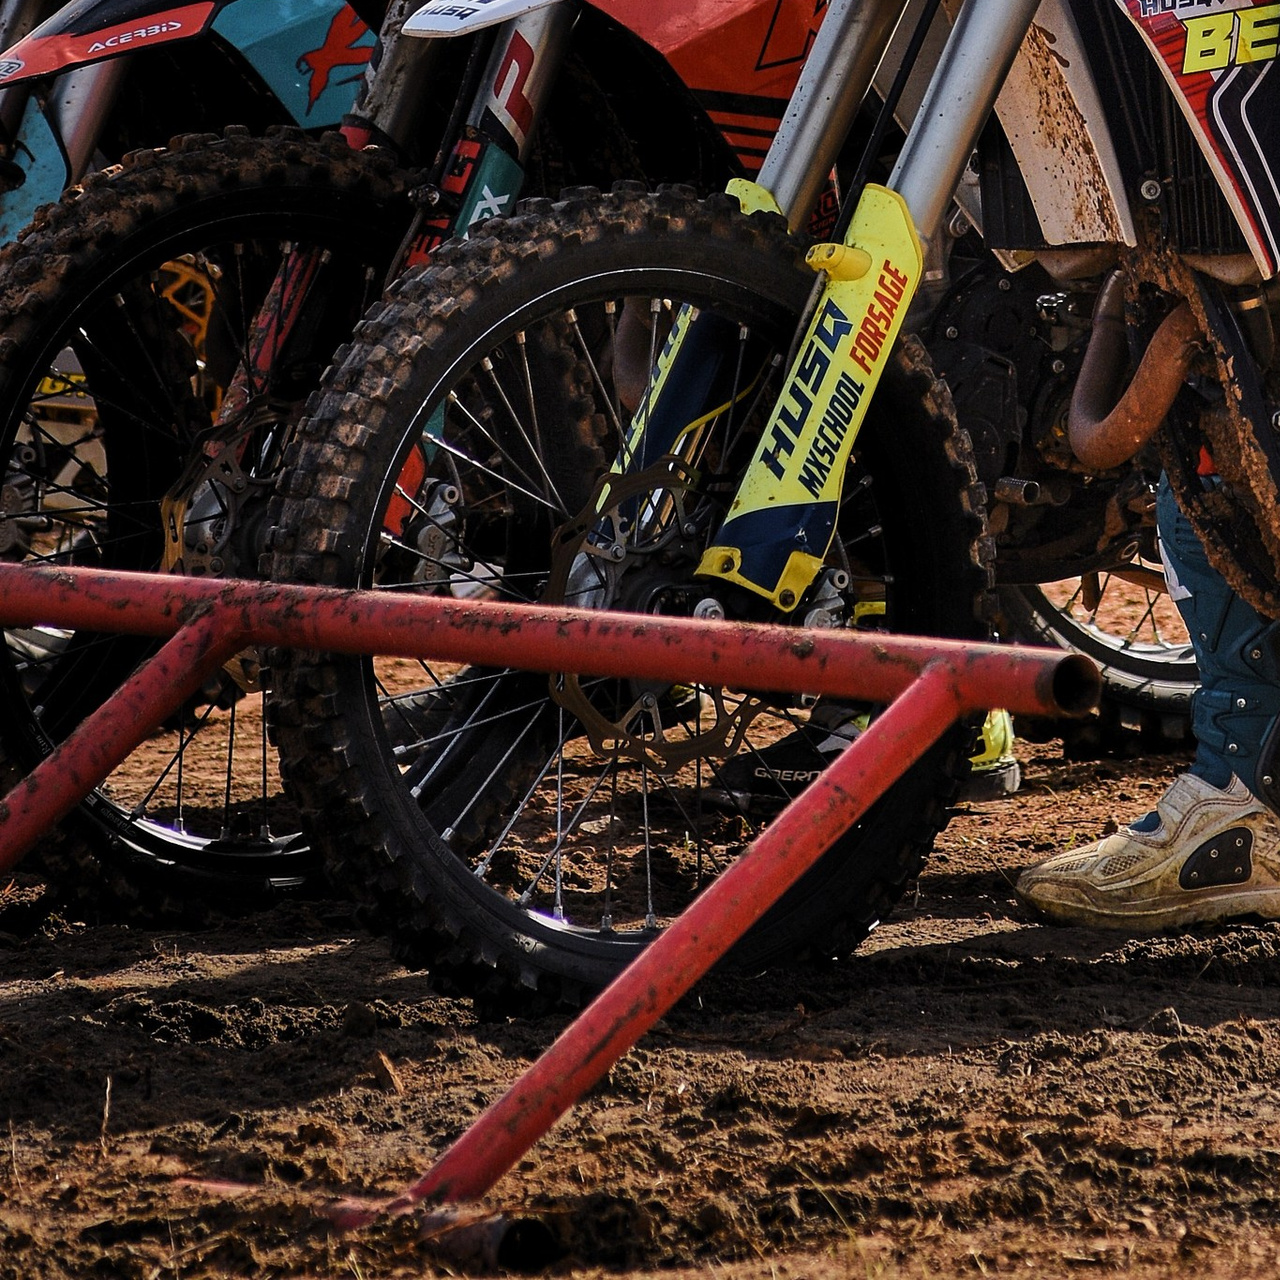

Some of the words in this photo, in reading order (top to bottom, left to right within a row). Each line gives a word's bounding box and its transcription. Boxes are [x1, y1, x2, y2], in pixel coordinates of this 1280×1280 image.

[849, 259, 909, 376] FORSAGE
[758, 297, 853, 482] HUSQ
[797, 369, 866, 501] MXSCHOOL
[754, 767, 822, 782] GAERN
